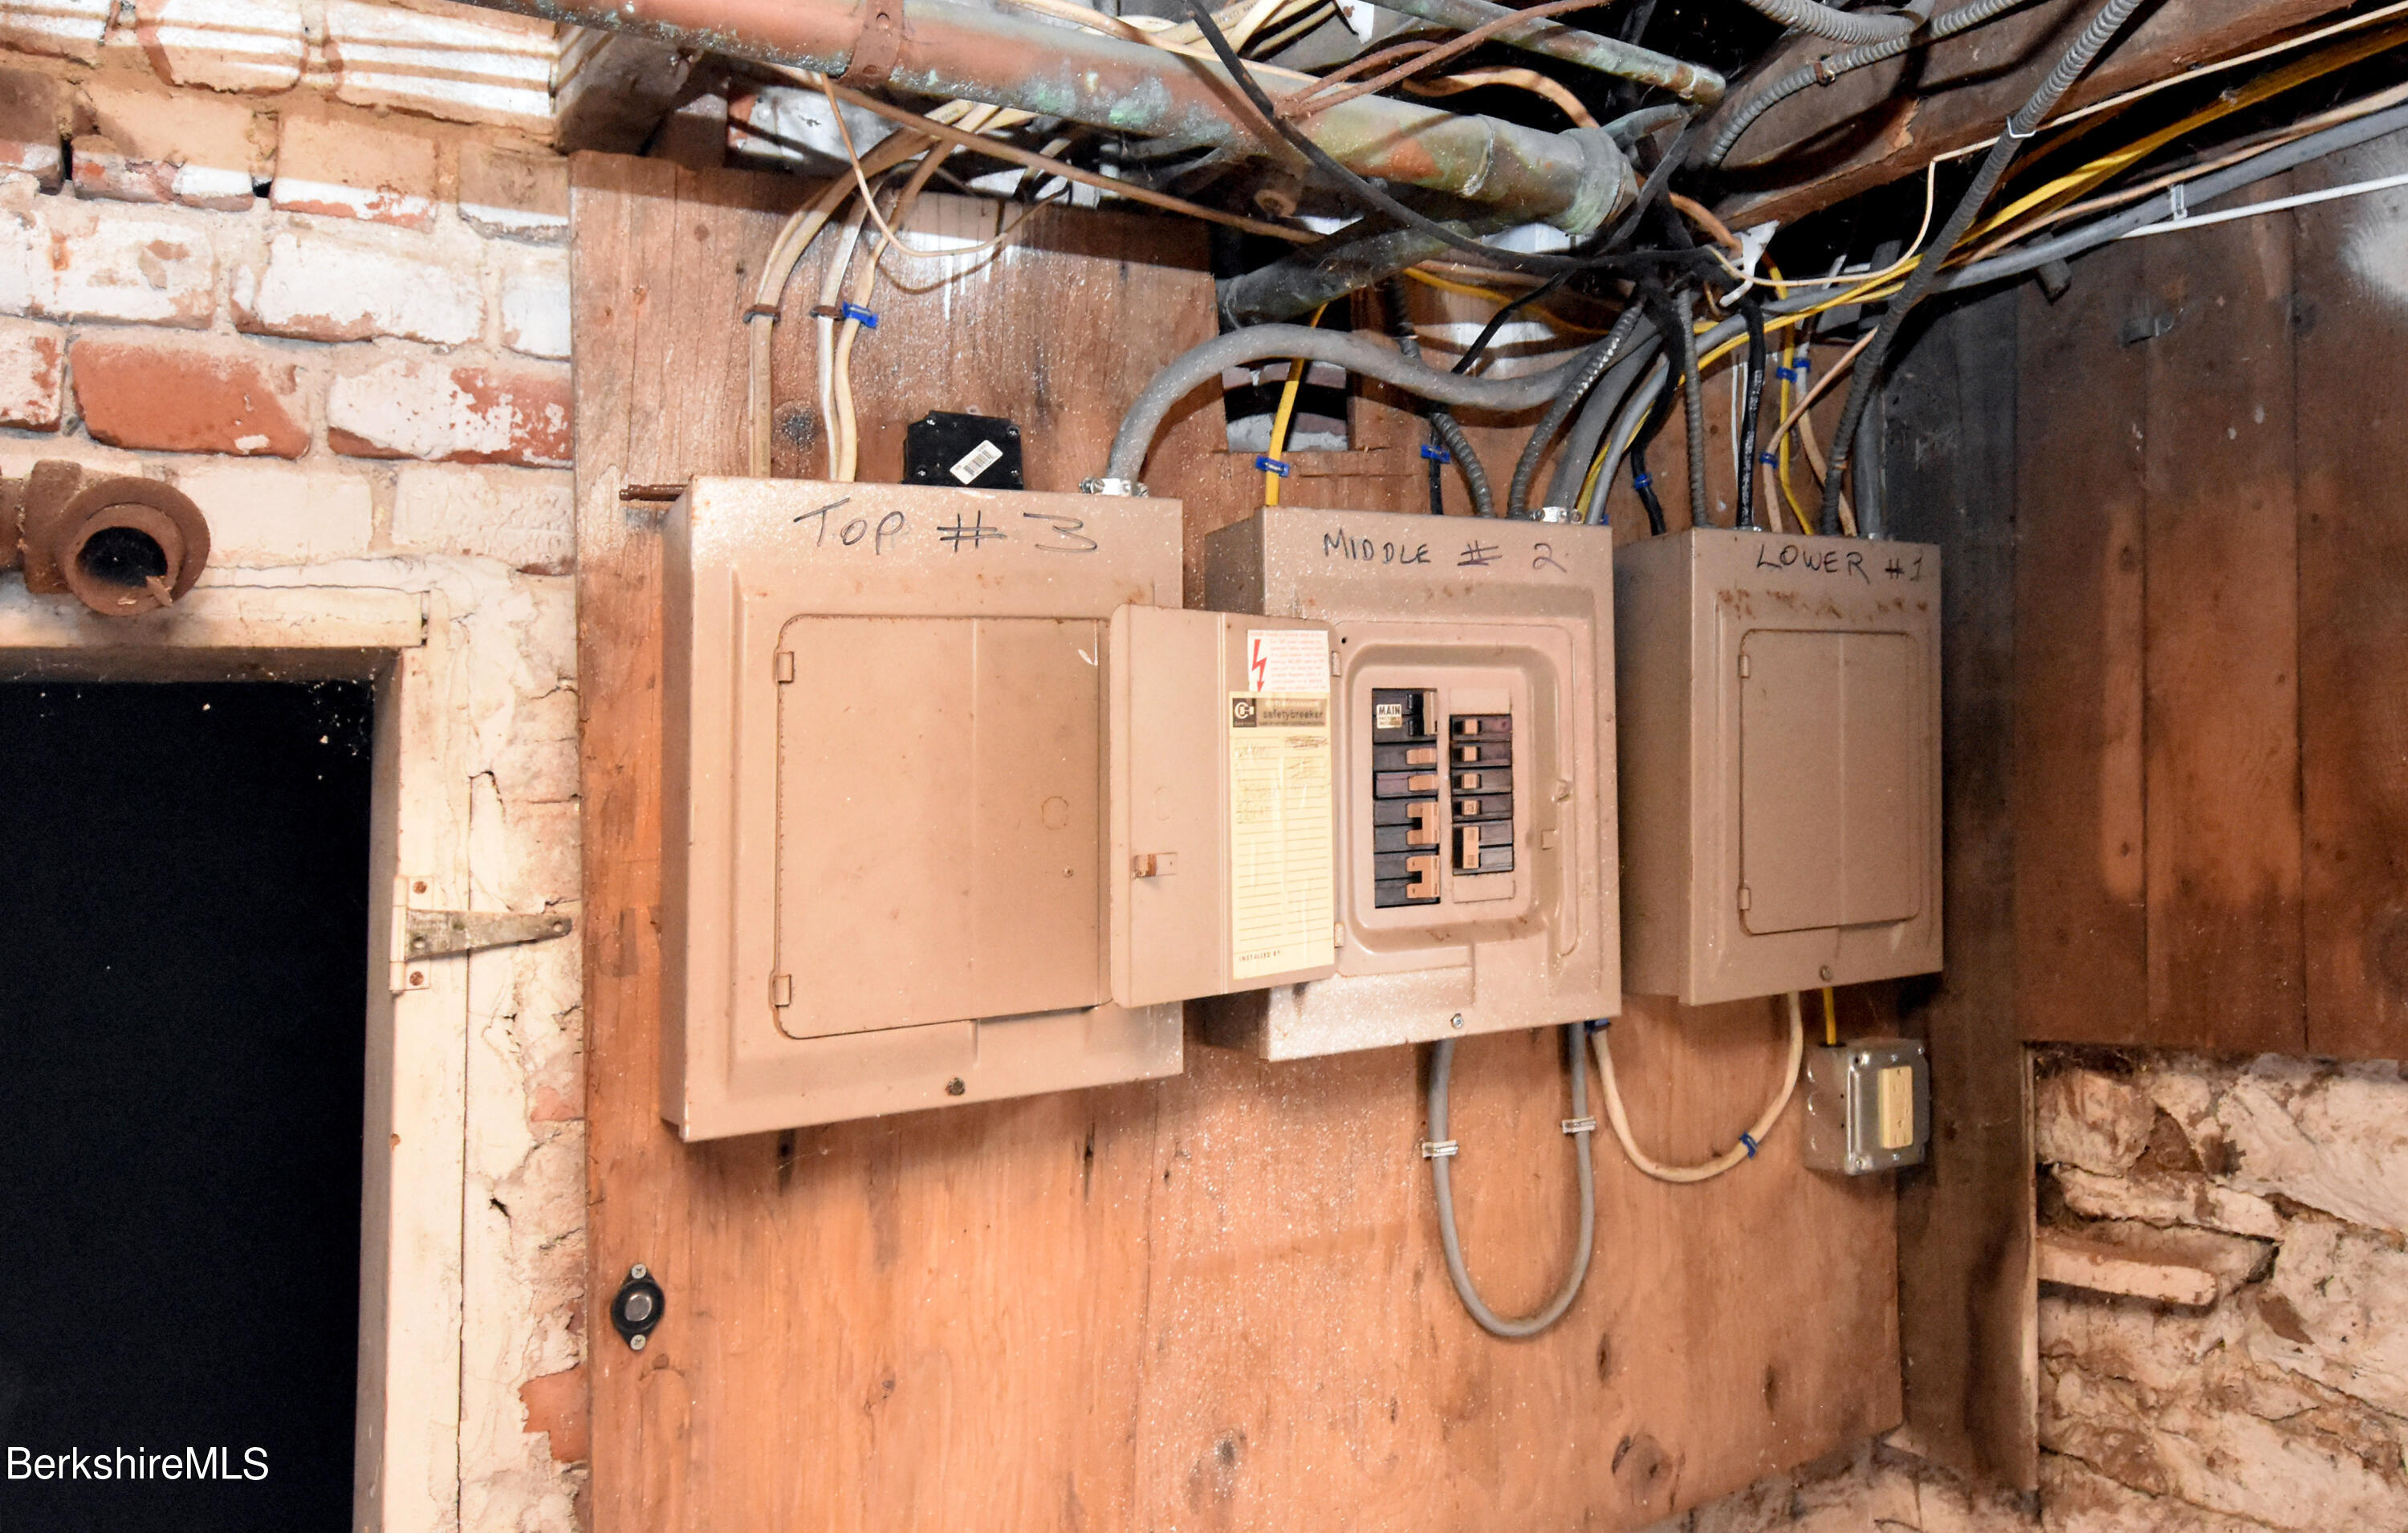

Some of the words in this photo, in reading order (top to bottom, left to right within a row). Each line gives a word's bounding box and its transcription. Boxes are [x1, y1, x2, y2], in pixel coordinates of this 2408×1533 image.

[937, 509, 1007, 553] #
[1023, 511, 1097, 553] 3
[1324, 527, 1431, 564] MIDDLE
[1457, 539, 1503, 567] #
[1532, 542, 1568, 573] 2
[1755, 543, 1870, 585] LOWER
[1263, 708, 1324, 721] safetybreaker
[1378, 706, 1401, 715] MAIN
